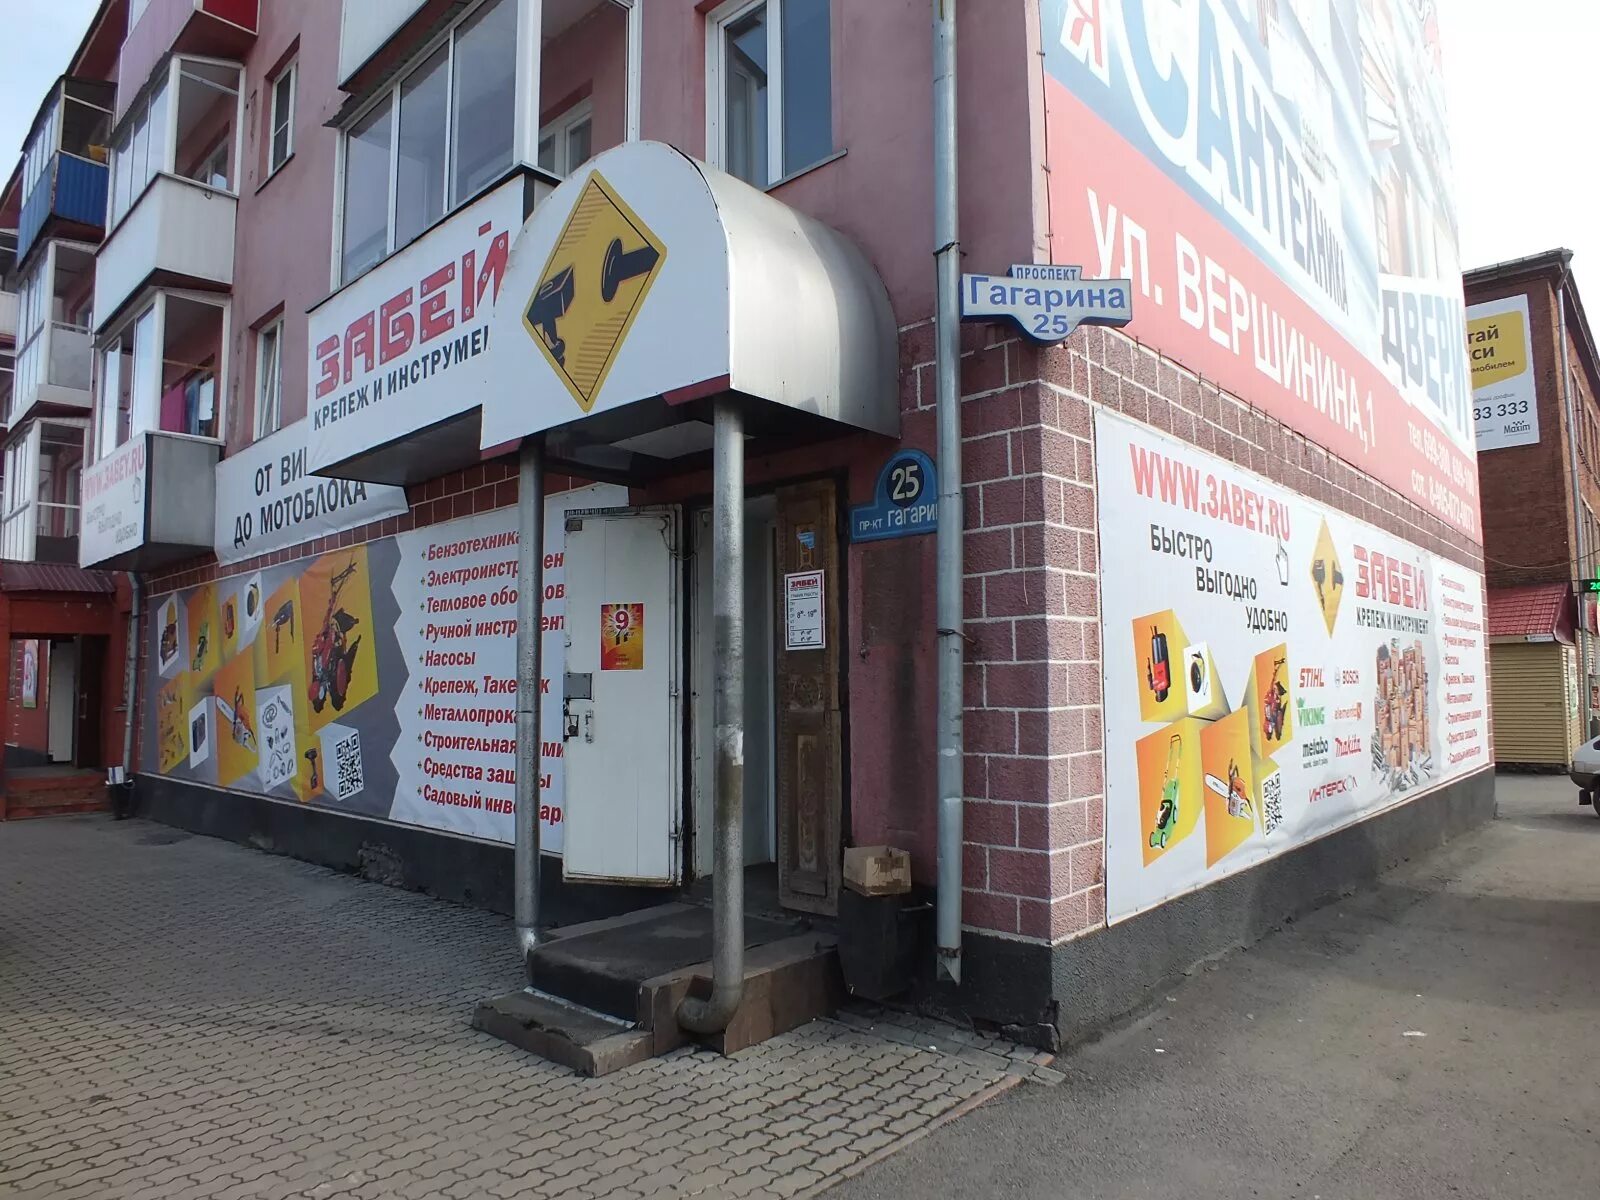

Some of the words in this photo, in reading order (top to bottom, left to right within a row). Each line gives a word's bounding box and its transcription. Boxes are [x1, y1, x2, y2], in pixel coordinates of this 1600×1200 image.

[1087, 186, 1163, 305] УЛ.
[1016, 266, 1077, 281] ПРОСПЕКТ
[970, 276, 1126, 313] Гагарина
[315, 220, 509, 399] ЗАБЕЙ
[1033, 314, 1069, 334] 25
[1381, 289, 1470, 441] ДВЕРИ
[313, 384, 369, 431] КРЕПЕЖ
[373, 377, 382, 403] И
[387, 325, 490, 397] ИНСТРУМЕ
[1497, 400, 1529, 417] 333
[1503, 422, 1531, 434] Maxim
[255, 463, 273, 497] ОТ
[891, 464, 920, 500] 25
[233, 512, 252, 549] ДО
[260, 480, 367, 536] МОТОБЛОКА
[1150, 523, 1213, 563] БЫСТРО
[1196, 566, 1257, 602] ВЫГОДНО
[1353, 544, 1428, 611] ЗАБЕЙ
[426, 591, 487, 615] Тепловое
[615, 611, 629, 629] 9
[1245, 605, 1288, 634] УДОБНО
[1356, 606, 1387, 629] КРЕПЕЖ
[1387, 611, 1393, 629] И
[425, 617, 472, 644] Ручной
[424, 649, 476, 667] Насосы
[424, 675, 479, 698] Крепеж,
[1299, 667, 1325, 688] STIHL
[1342, 669, 1360, 685] BOSCH
[1297, 706, 1325, 727] VIKING
[423, 730, 517, 754] Строительная
[1302, 737, 1328, 758] metabo
[423, 757, 484, 780] Средства
[423, 783, 482, 810] Садовый
